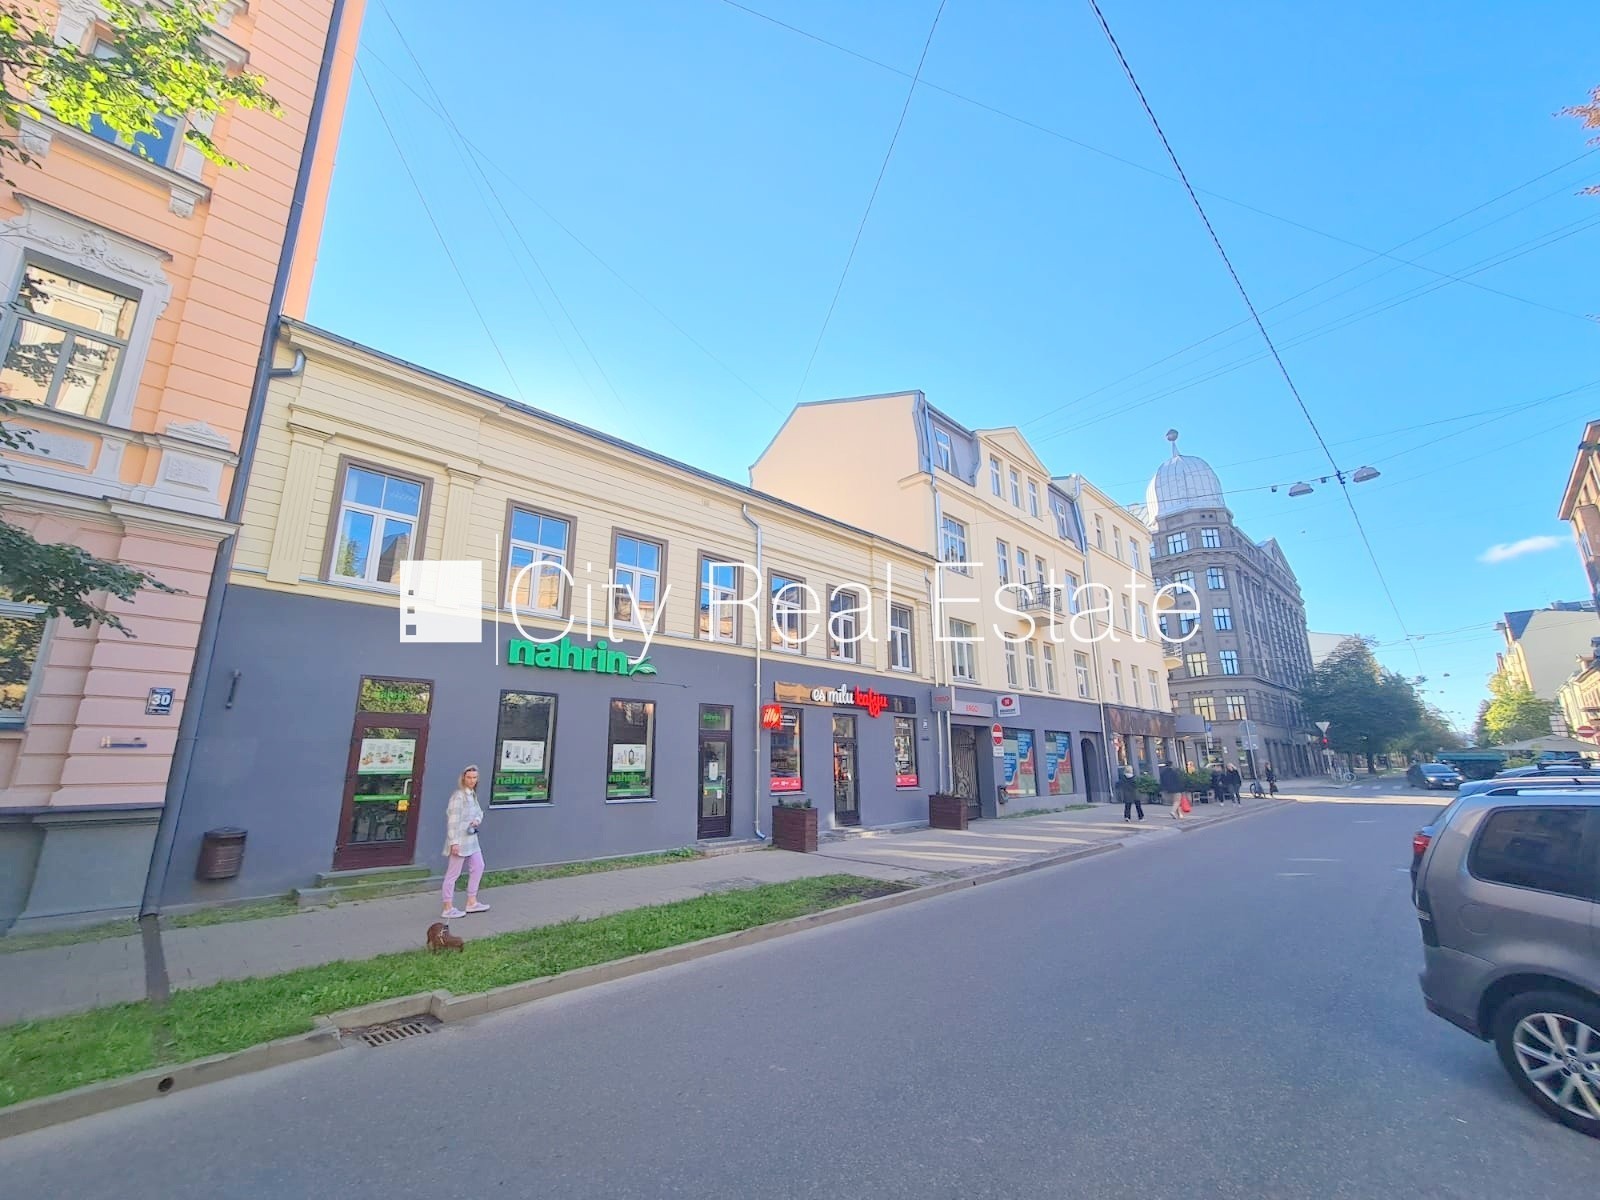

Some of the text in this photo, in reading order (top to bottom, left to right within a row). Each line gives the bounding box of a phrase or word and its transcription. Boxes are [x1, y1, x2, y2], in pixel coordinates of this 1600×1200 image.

[508, 638, 630, 675] nahrin
[151, 694, 171, 706] 30
[812, 688, 826, 702] es
[763, 707, 780, 726] illy
[495, 773, 536, 785] nahrin
